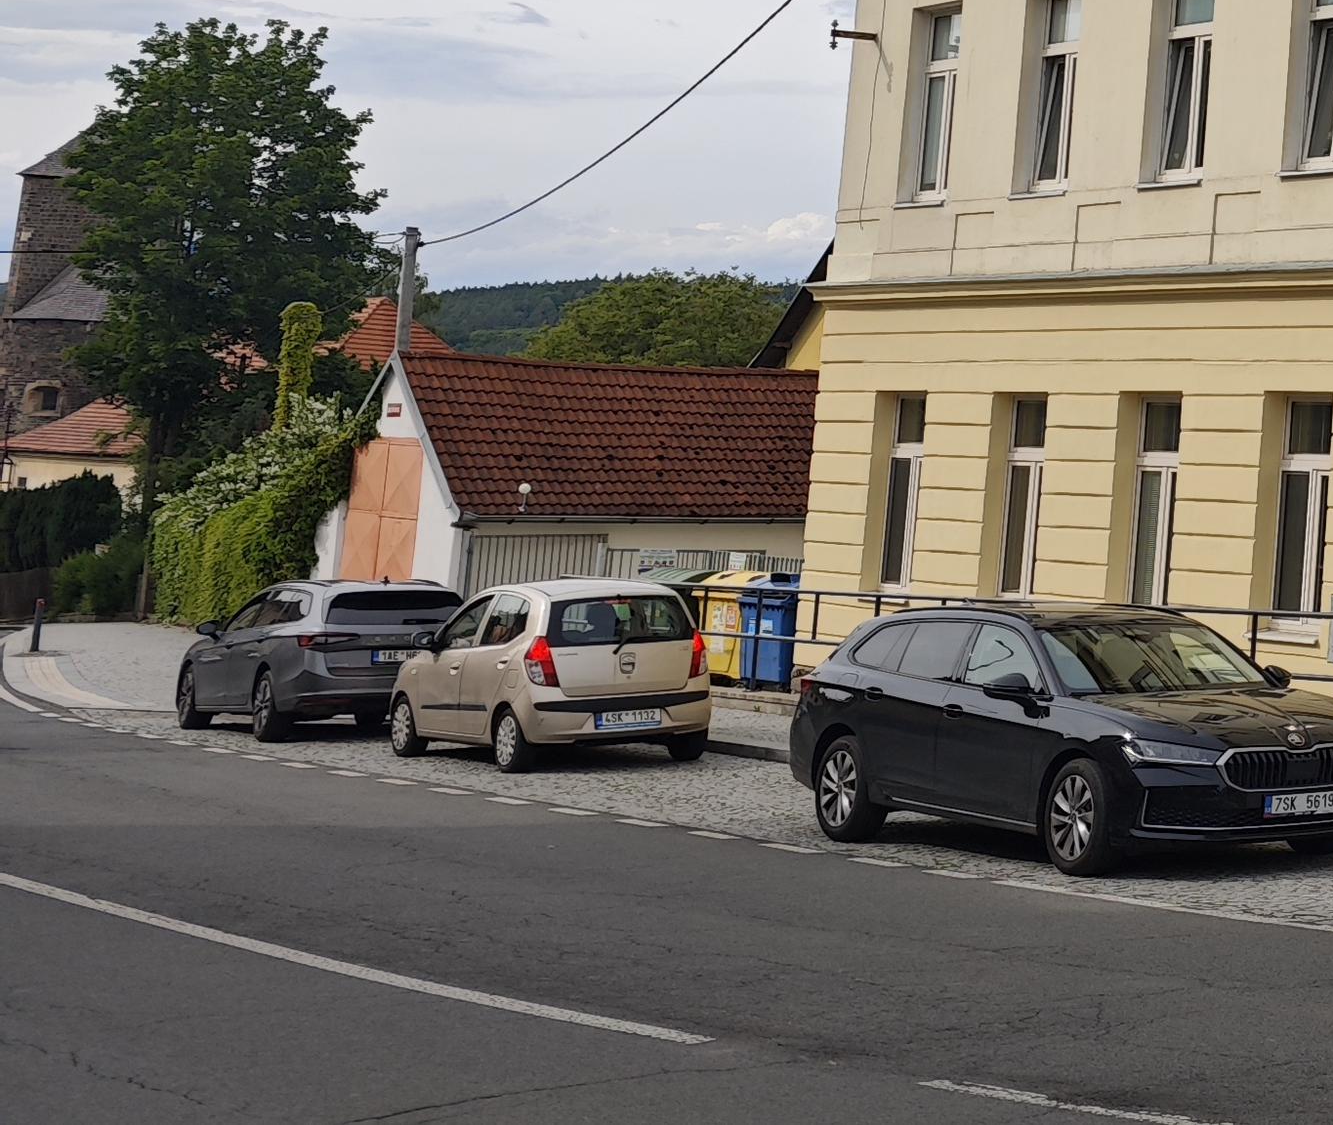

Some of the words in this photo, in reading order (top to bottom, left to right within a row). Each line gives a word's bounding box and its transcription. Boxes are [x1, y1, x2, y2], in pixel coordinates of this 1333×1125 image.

[382, 651, 399, 661] 1AE
[605, 712, 624, 723] 4SK
[632, 710, 656, 722] 1132
[1274, 796, 1297, 812] 7SK
